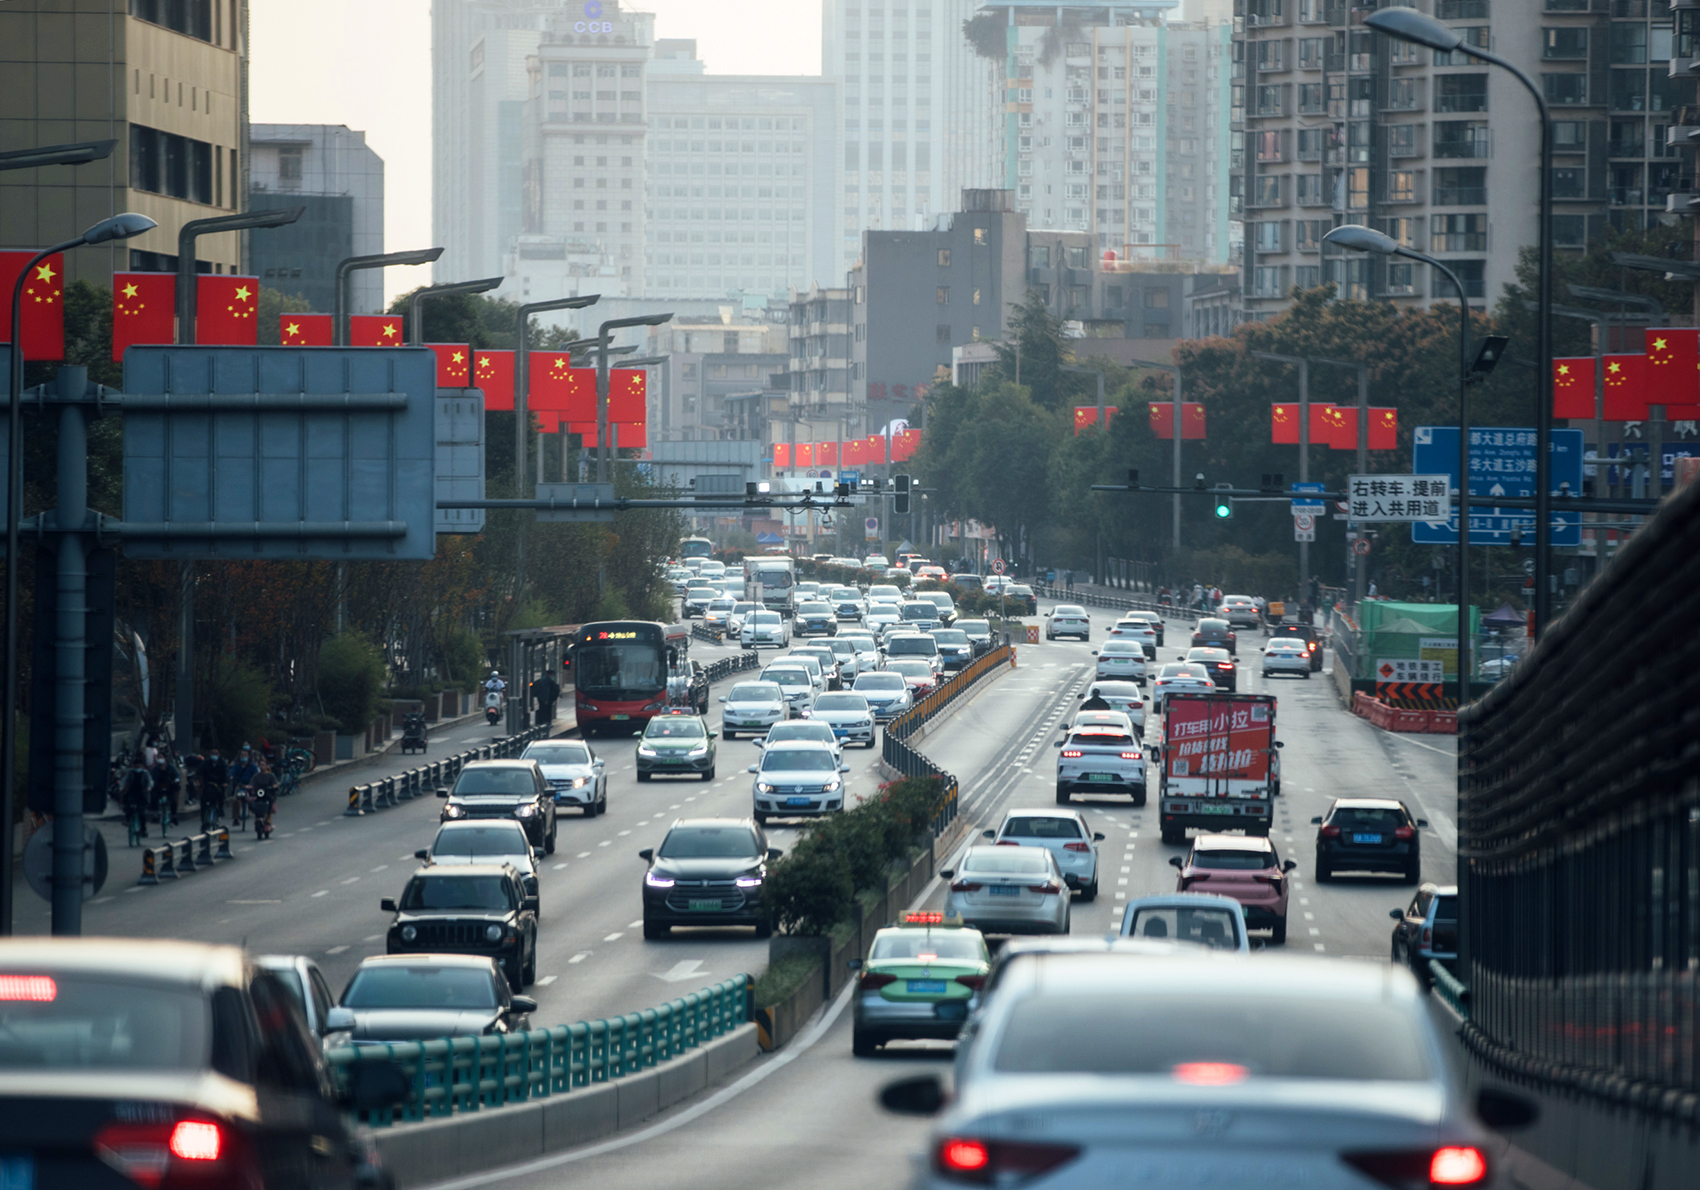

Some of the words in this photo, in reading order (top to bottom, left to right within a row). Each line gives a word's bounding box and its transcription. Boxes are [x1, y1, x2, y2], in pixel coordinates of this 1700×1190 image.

[574, 21, 613, 33] CCB
[1352, 480, 1447, 497] 右转车、提前
[1396, 662, 1442, 671] 地铁施工
[1396, 672, 1442, 681] 车辆绕行
[1175, 710, 1249, 737] 打车用小拉
